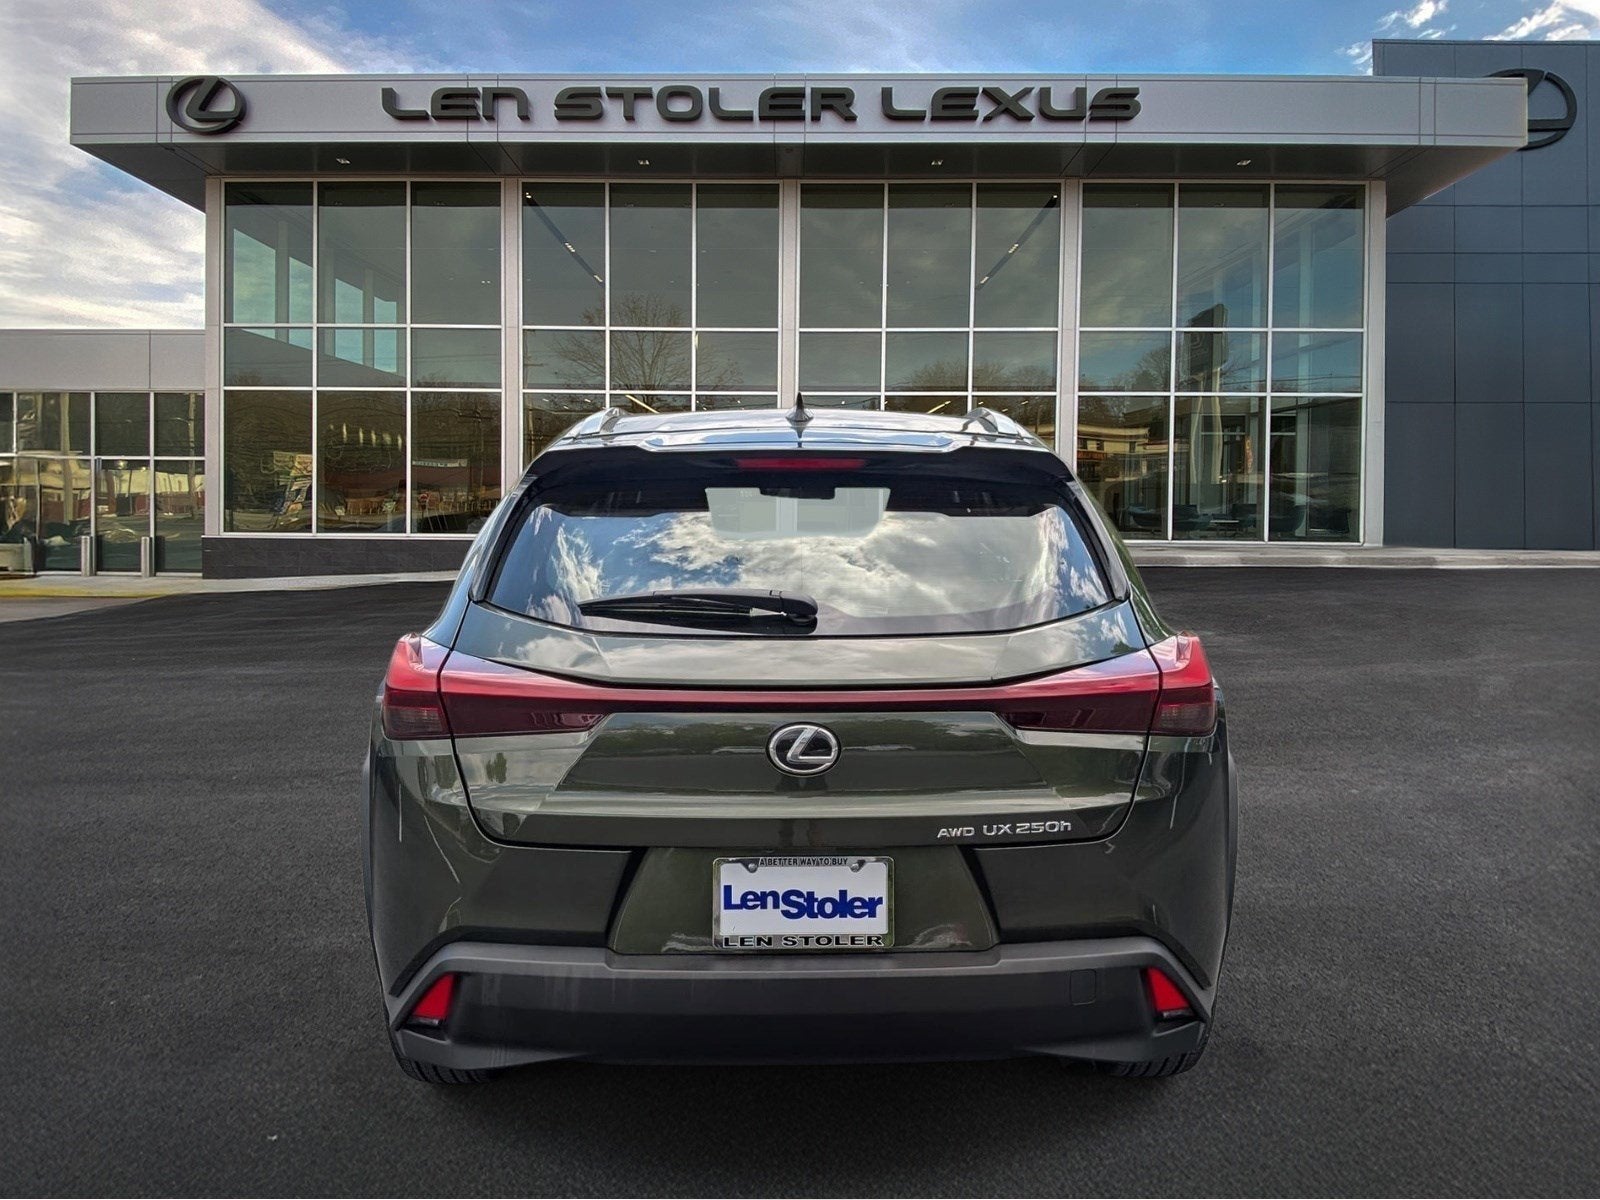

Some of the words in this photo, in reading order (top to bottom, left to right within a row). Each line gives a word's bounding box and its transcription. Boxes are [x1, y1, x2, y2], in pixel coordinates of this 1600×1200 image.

[381, 87, 530, 121] LEN
[554, 85, 859, 122] STOLER
[881, 86, 1141, 121] LEXUS
[937, 826, 975, 839] AWD
[982, 823, 1013, 836] UX
[1015, 820, 1072, 834] 250h
[767, 857, 798, 867] BETTER
[800, 857, 816, 866] WAY
[819, 857, 831, 866] TO
[832, 857, 848, 866] BUY
[723, 936, 773, 947] LEN
[782, 935, 884, 947] STOLER
